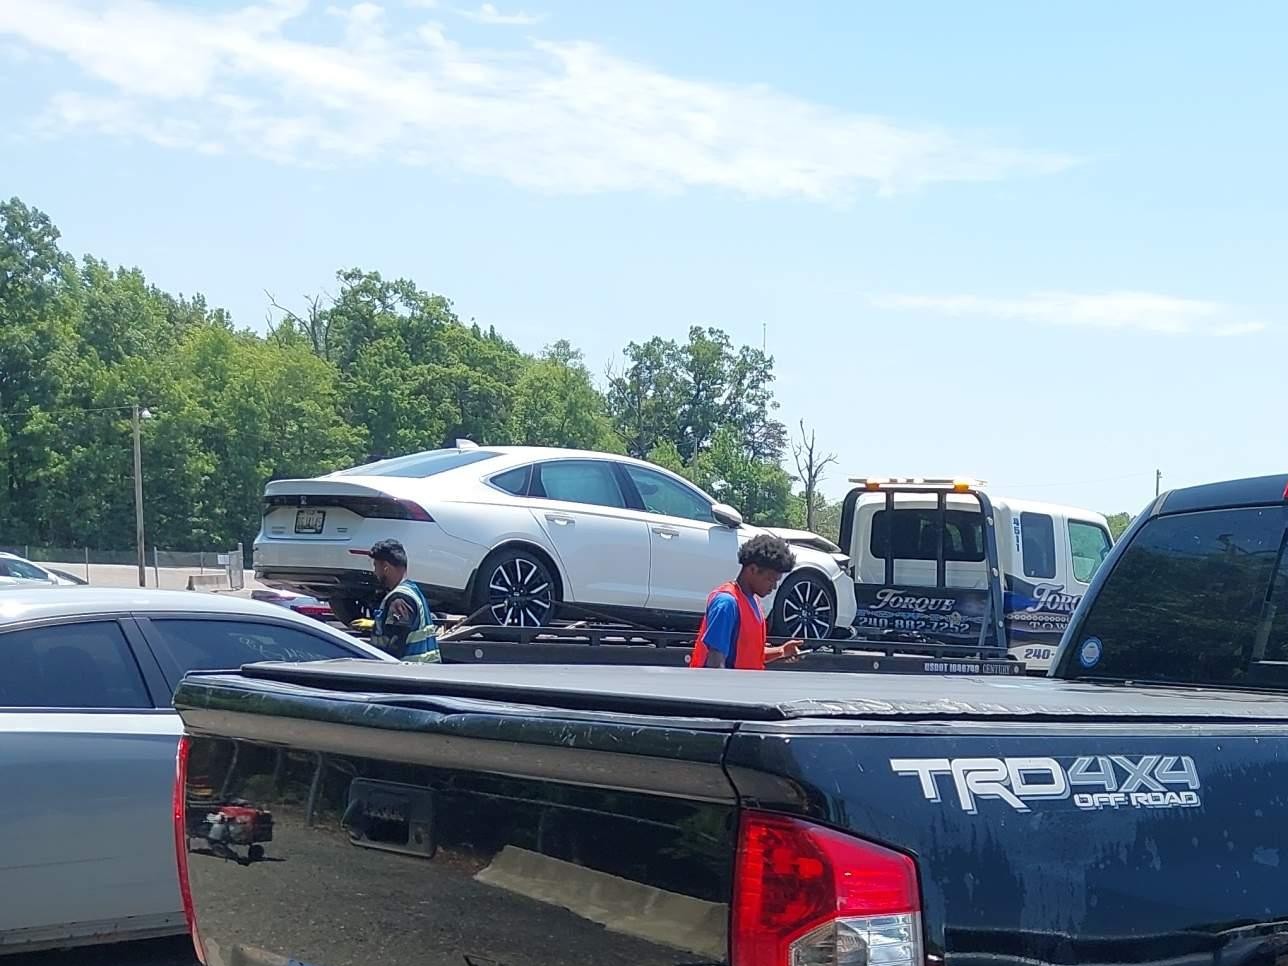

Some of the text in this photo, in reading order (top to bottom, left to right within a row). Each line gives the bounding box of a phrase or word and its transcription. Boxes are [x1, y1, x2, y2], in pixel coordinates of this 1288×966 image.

[869, 589, 956, 612] TORQUE
[924, 662, 948, 673] USDOT
[889, 755, 1201, 815] TRD 4X4
[1073, 791, 1201, 811] OFF ROAD
